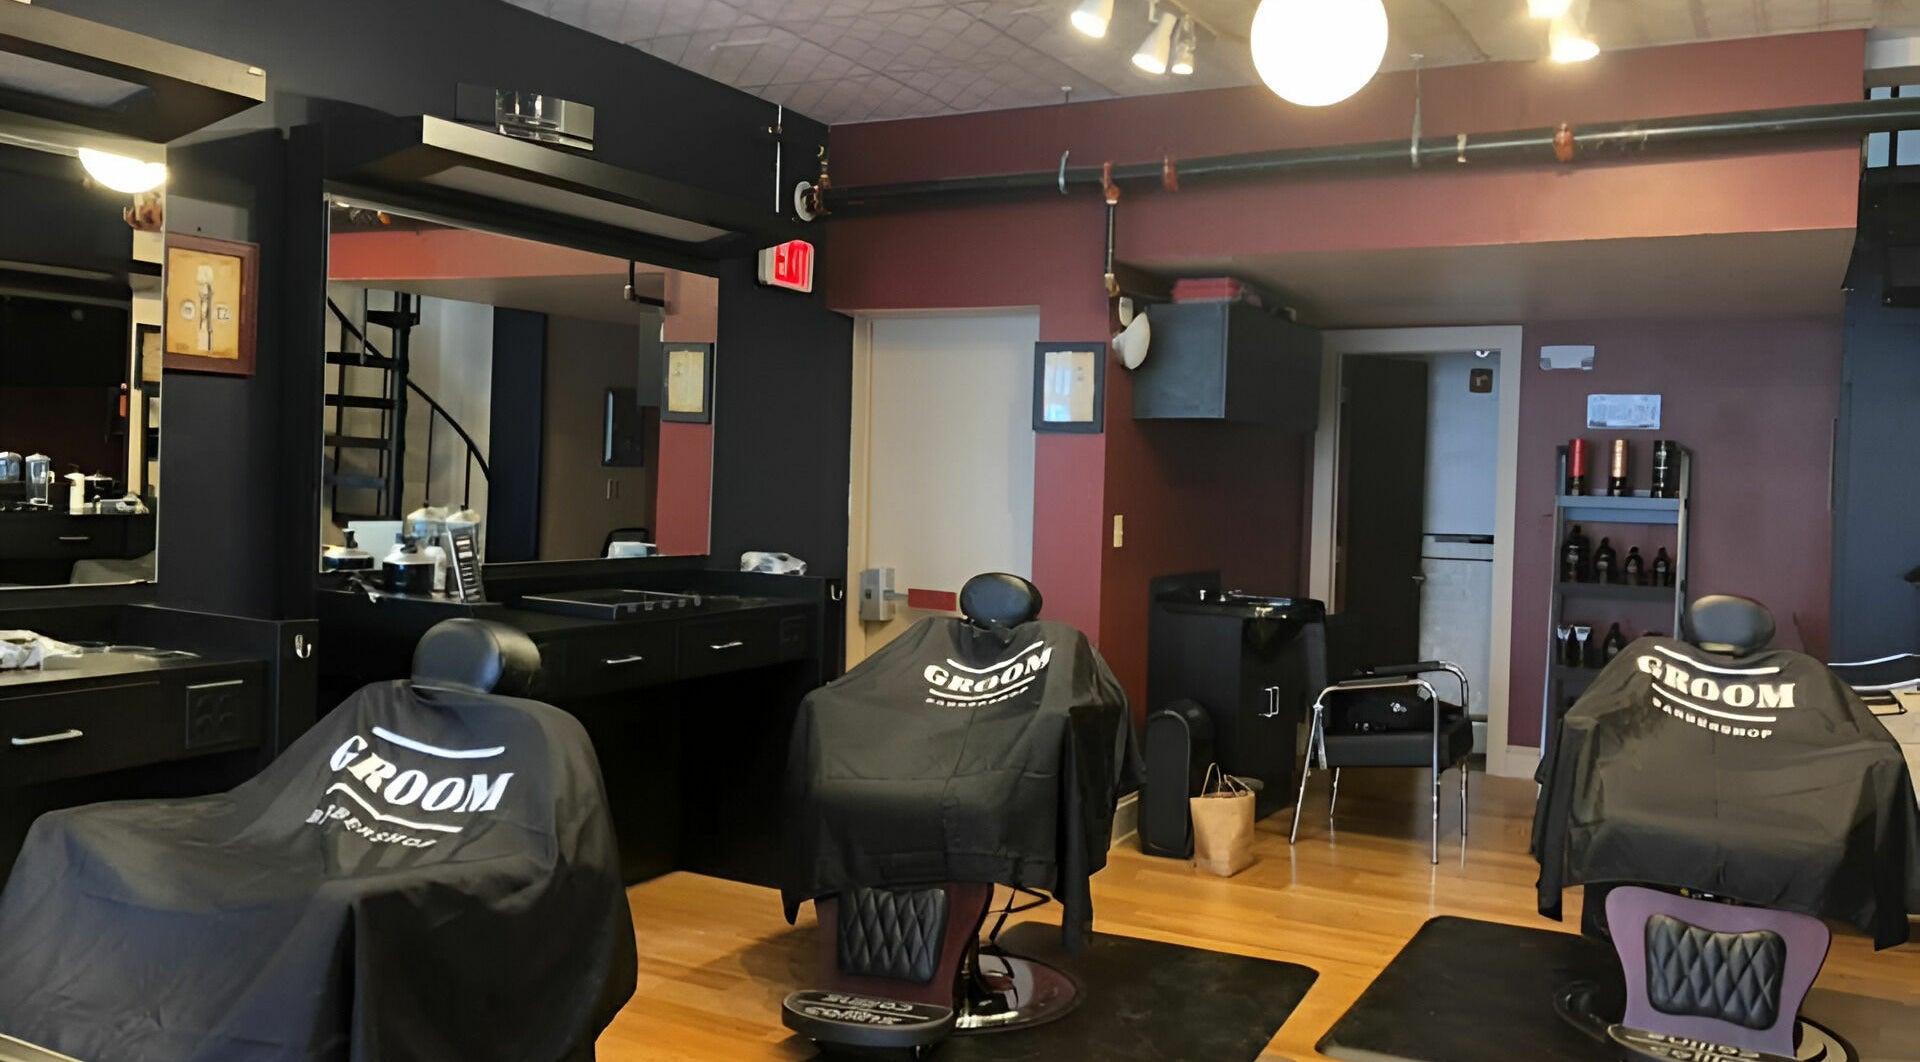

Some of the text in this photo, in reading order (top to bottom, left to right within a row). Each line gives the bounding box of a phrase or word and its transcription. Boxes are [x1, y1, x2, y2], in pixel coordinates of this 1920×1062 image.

[774, 240, 809, 288] EXIT
[923, 646, 1053, 693] GROOM
[1636, 654, 1796, 709] GROOM
[330, 735, 513, 812] GROOM
